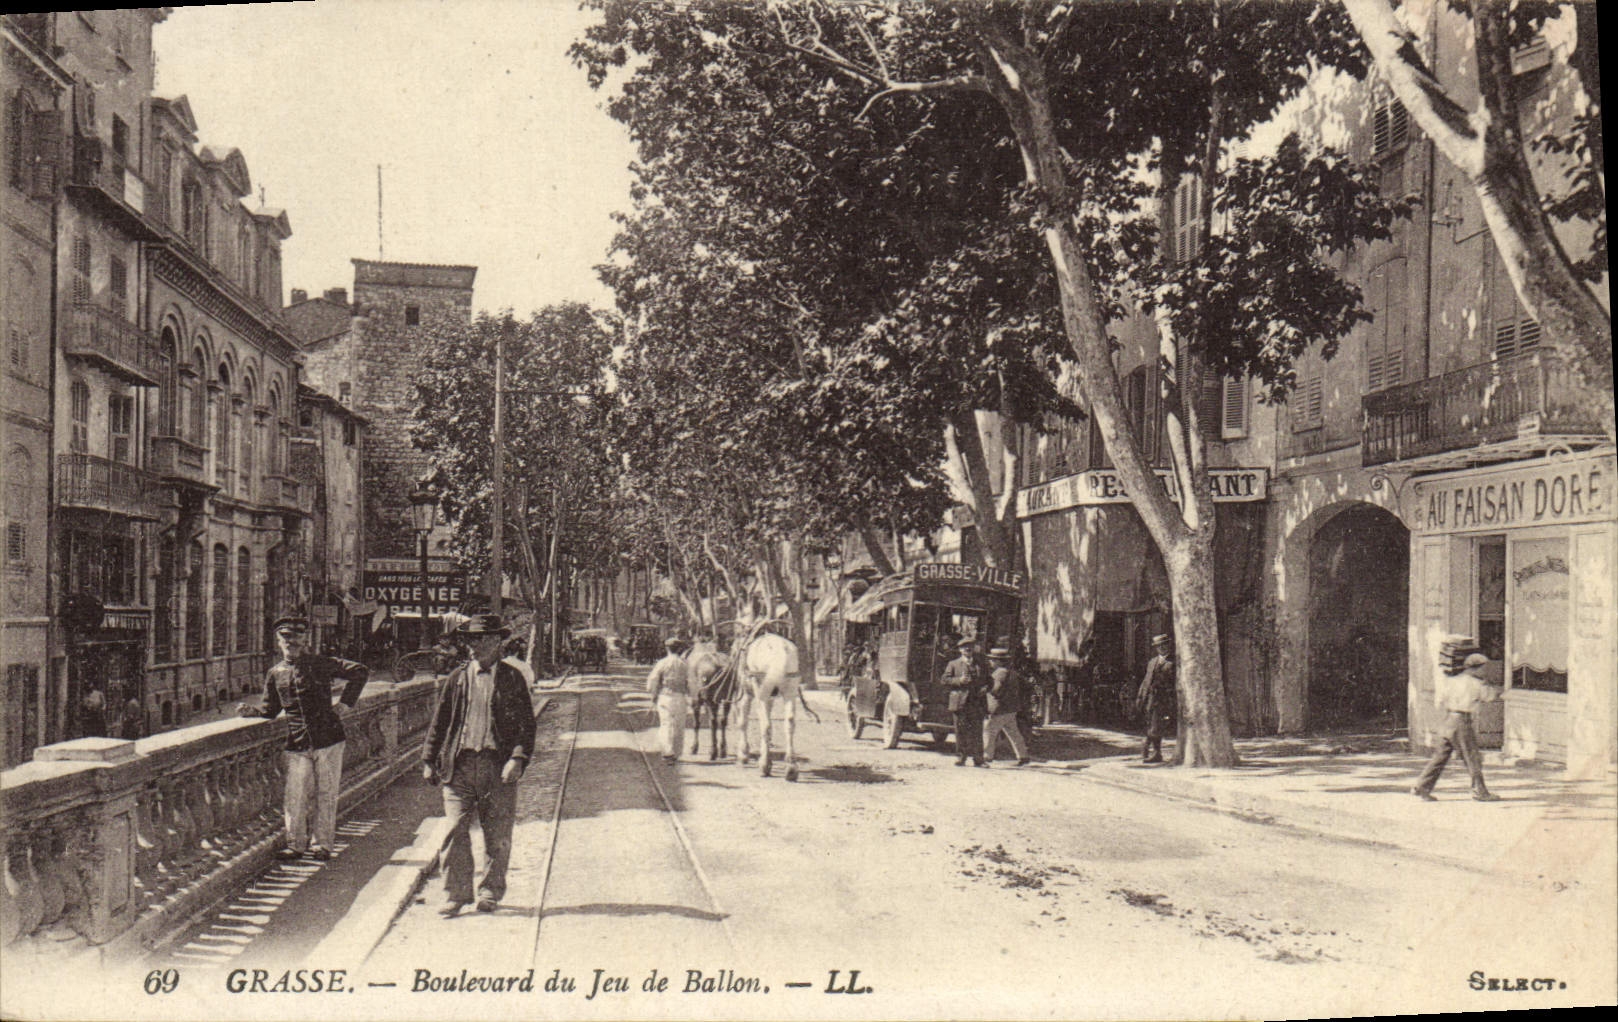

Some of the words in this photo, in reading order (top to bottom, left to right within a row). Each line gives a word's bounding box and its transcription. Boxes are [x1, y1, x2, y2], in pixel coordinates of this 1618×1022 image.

[1089, 474, 1257, 498] REAANT
[1427, 490, 1448, 529] AU
[1453, 480, 1526, 528] FAISAN
[1533, 464, 1603, 521] DORÉ
[919, 564, 1022, 590] GRASSE-VILLE
